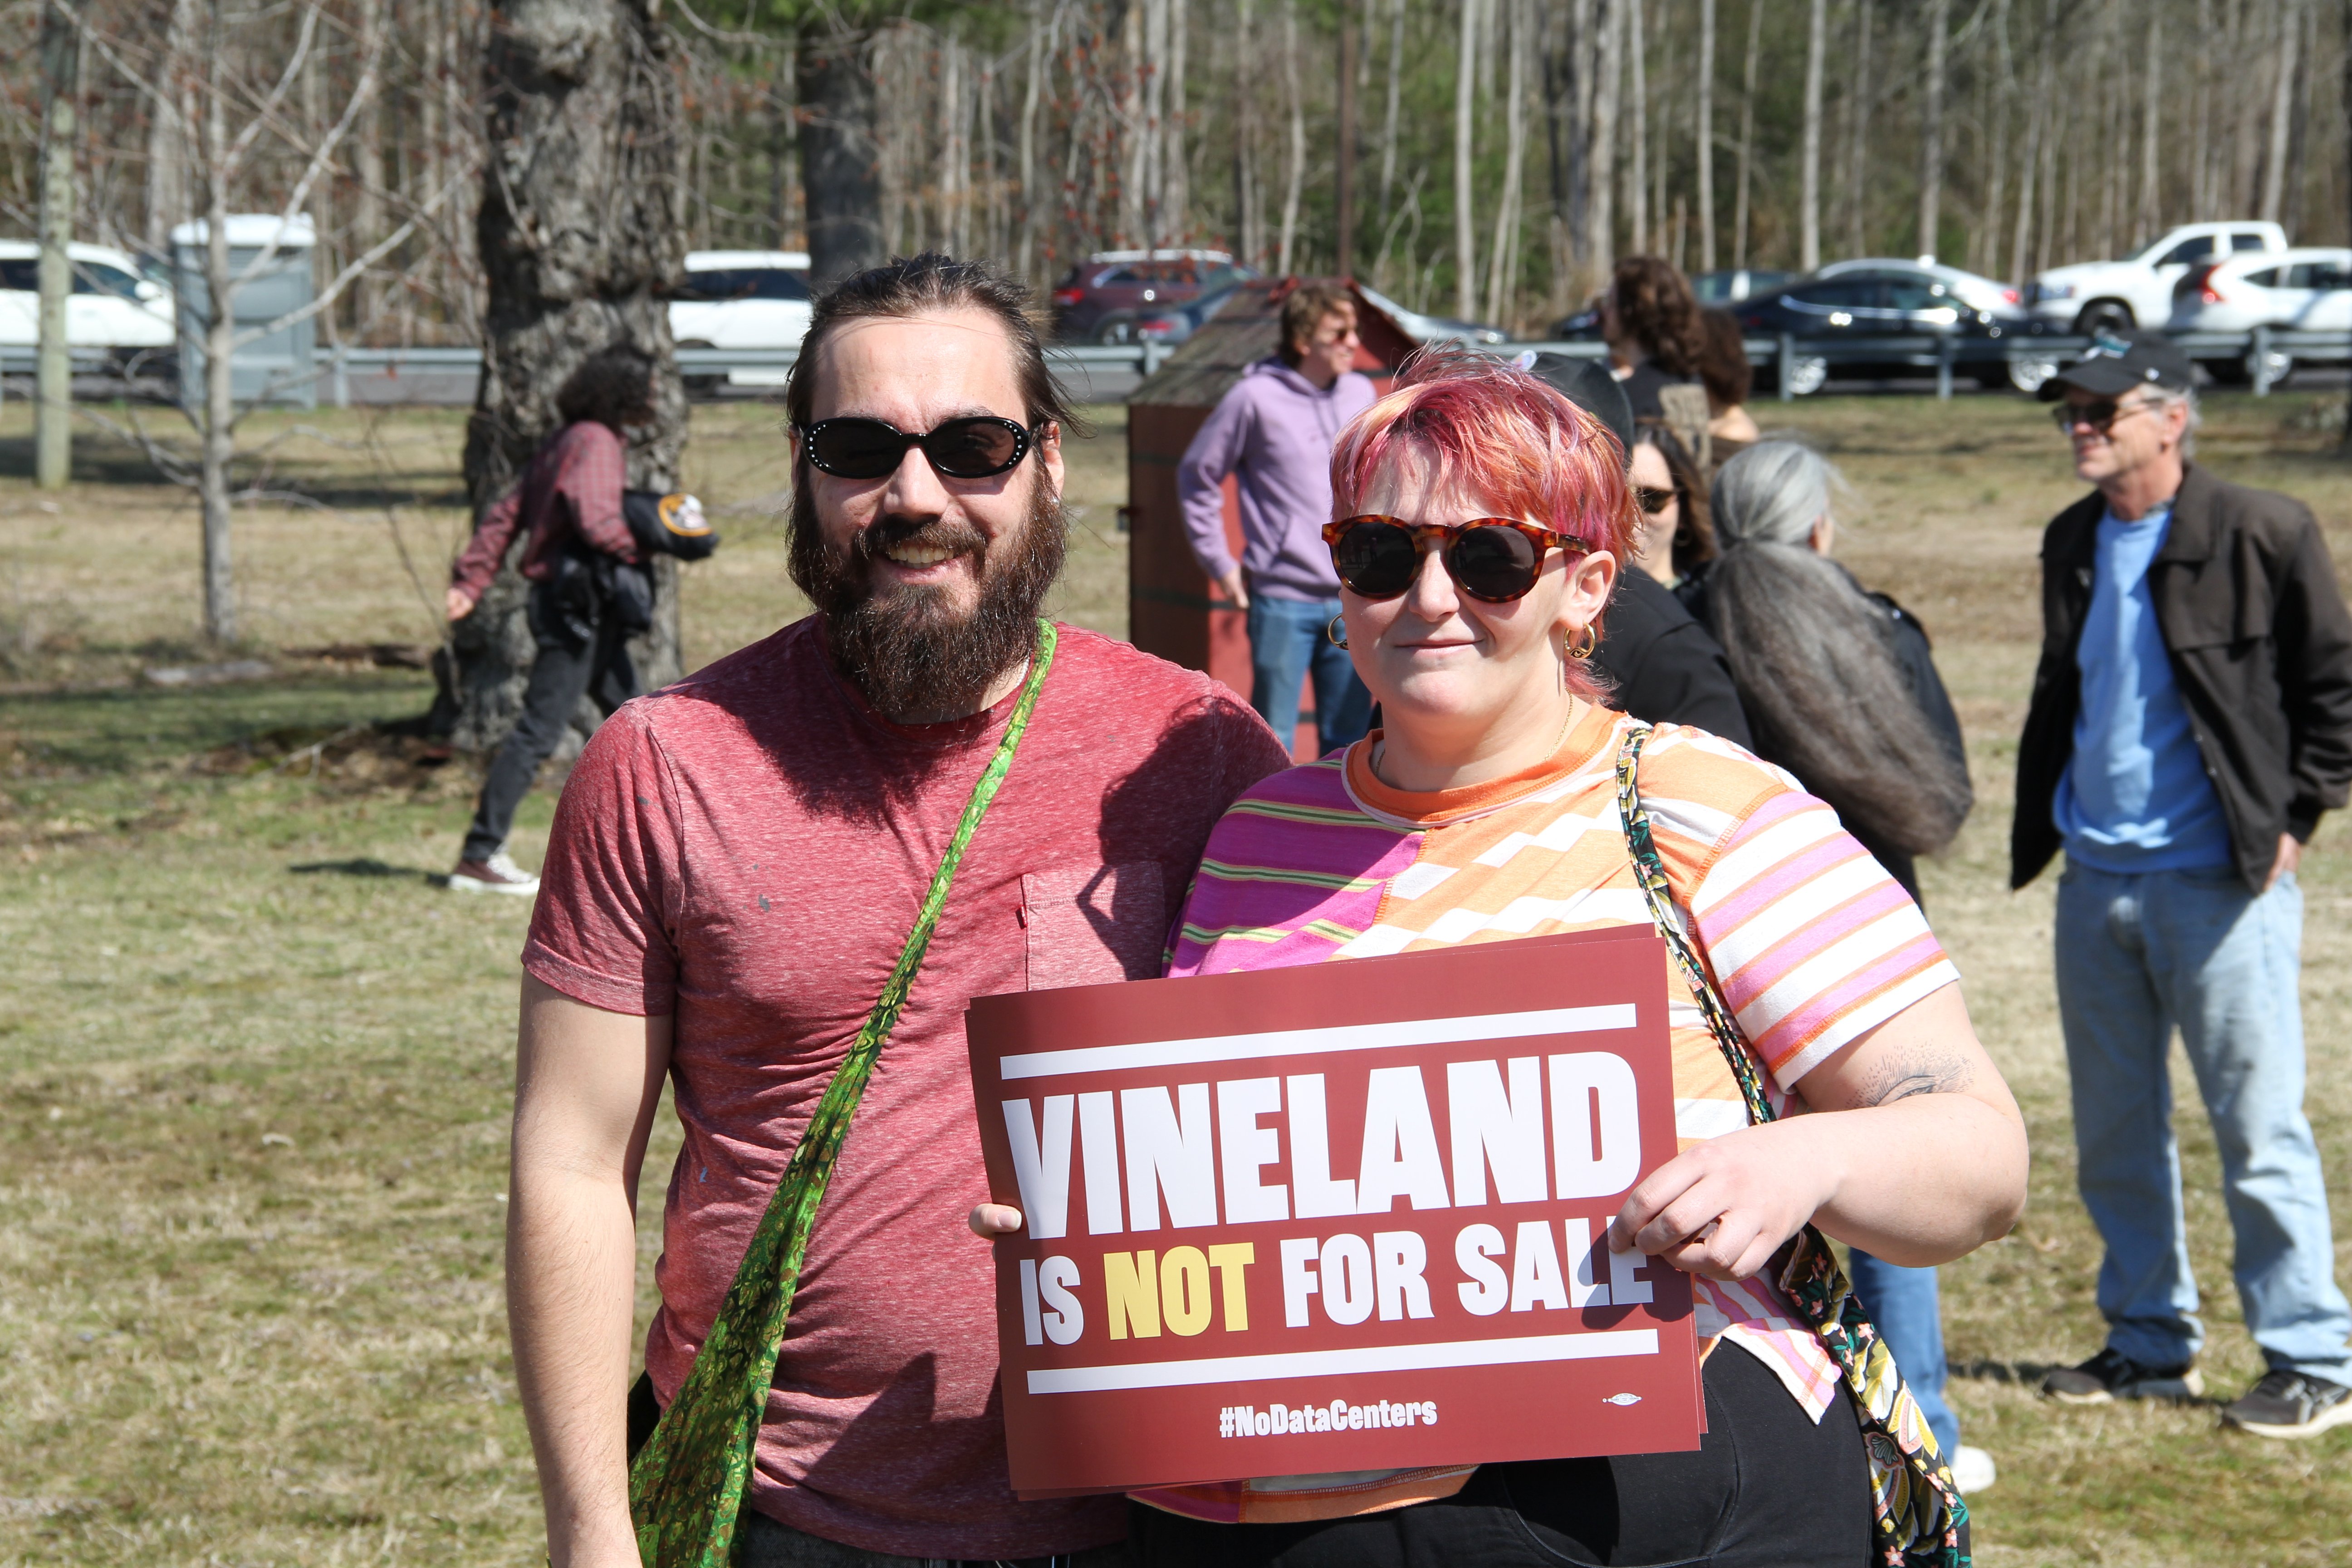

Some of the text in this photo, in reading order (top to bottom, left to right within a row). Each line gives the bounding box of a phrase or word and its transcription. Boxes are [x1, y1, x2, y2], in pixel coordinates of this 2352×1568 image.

[1001, 1051, 1641, 1239] VINELAND
[1020, 1216, 1654, 1345] IS NOT FOR SALE
[1219, 1399, 1437, 1438] #NoDataCenters
